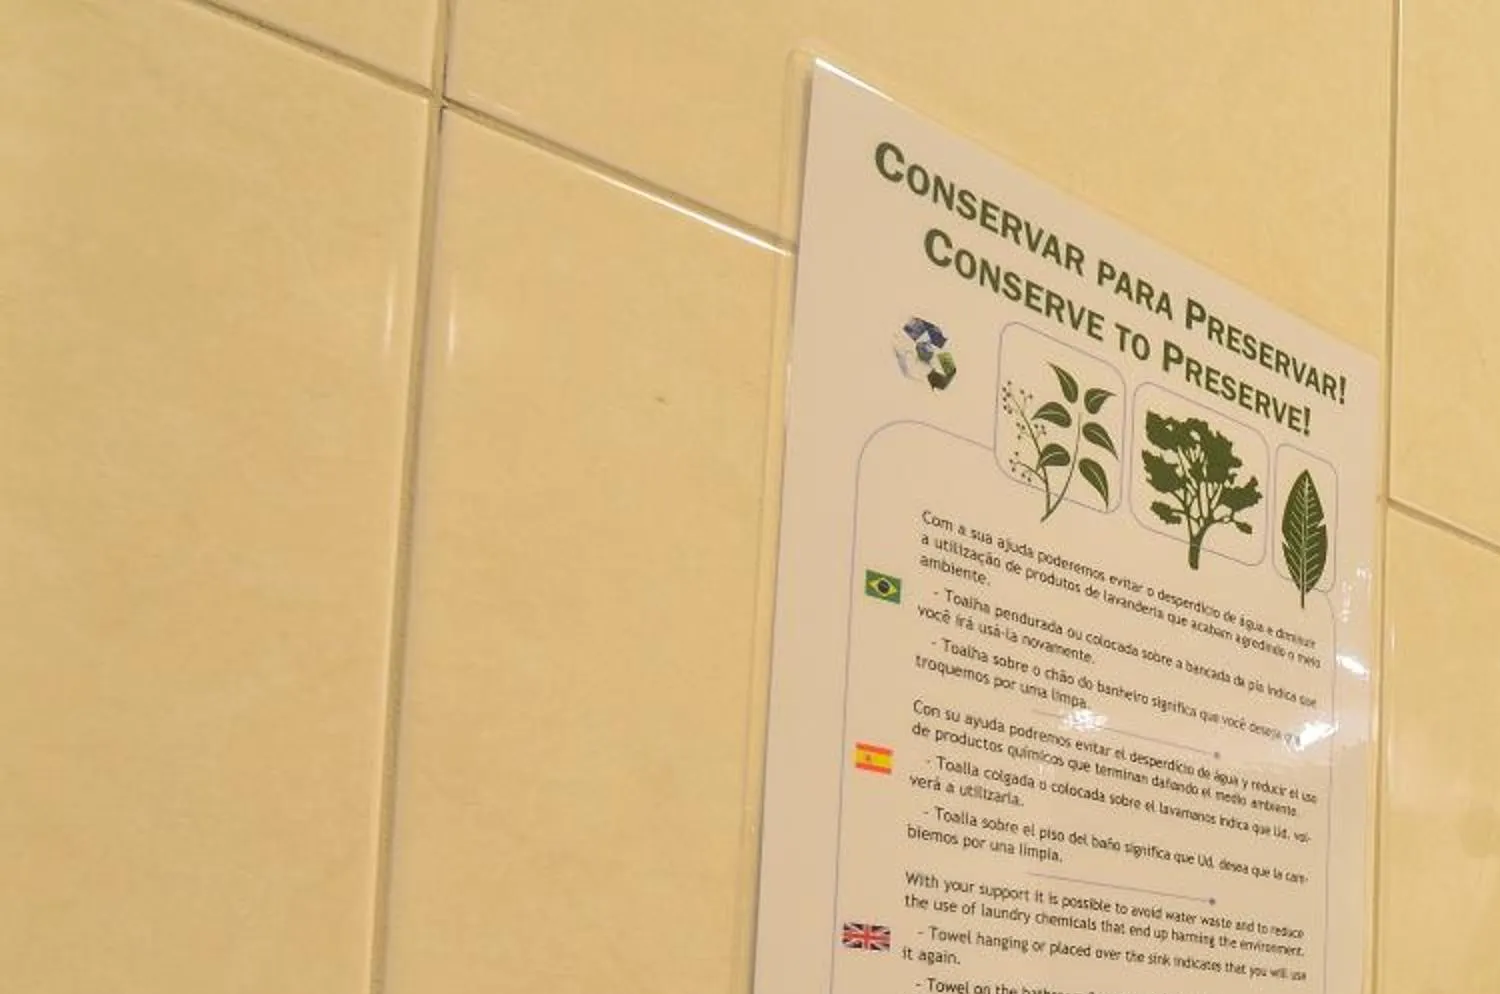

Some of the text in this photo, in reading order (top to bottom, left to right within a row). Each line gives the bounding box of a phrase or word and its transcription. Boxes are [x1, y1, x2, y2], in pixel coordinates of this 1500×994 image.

[875, 143, 1346, 404] CONSERVAR PARA PRESERVAR!
[924, 229, 1310, 436] CONSERVE TO PRESERVE!
[921, 510, 953, 532] Com
[957, 525, 967, 536] a
[970, 529, 993, 545] sua
[997, 537, 1034, 559] ajuda
[1037, 551, 1105, 582] poderemos
[1109, 575, 1144, 593] evitar
[1147, 587, 1155, 597] o
[1223, 610, 1237, 624] de
[921, 533, 930, 546] a
[934, 538, 1001, 569] utilização
[1005, 559, 1023, 575] de
[1025, 567, 1081, 594] produtos
[1083, 584, 1101, 600] de
[1103, 589, 1165, 620] lavanderia
[1167, 613, 1188, 627] que
[1287, 651, 1295, 661] o
[944, 587, 991, 615] Toalha
[994, 607, 1063, 635] pendurada
[1067, 627, 1083, 641] ou
[1085, 632, 1139, 657] colocada
[1141, 649, 1173, 667] sobre
[1175, 659, 1183, 670] a
[1021, 633, 1096, 665] novamente.
[915, 654, 1049, 699] troquemos por uma
[941, 637, 989, 663] Toalha
[993, 655, 1029, 673] sobre
[1032, 665, 1041, 677] o
[1077, 676, 1094, 691] do
[910, 721, 932, 738] de
[934, 728, 1004, 754] productos
[1067, 758, 1092, 774] que
[1094, 762, 1149, 785] terminan
[1200, 786, 1212, 799] el
[912, 698, 942, 719] Con
[944, 709, 961, 724] su
[963, 714, 1006, 734] ayuda
[1008, 724, 1072, 749] podremos
[1074, 739, 1112, 757] evitar
[1114, 748, 1127, 761] el
[1196, 766, 1211, 781] de
[1288, 788, 1299, 800] el
[909, 775, 942, 792] verá
[945, 783, 955, 794] a
[936, 755, 979, 777] Toalla
[983, 769, 1035, 789] colgada
[1039, 780, 1047, 791] o
[1049, 781, 1106, 803] colocada
[1109, 793, 1142, 810] sobre
[1144, 799, 1156, 813] el
[1251, 823, 1271, 837] que
[906, 823, 1063, 864] biemos por una limpia.
[934, 805, 978, 827] Toalla
[981, 817, 1019, 834] sobre
[1022, 823, 1035, 837] el
[1039, 827, 1065, 842] piso
[1068, 831, 1089, 847] del
[1173, 852, 1195, 865] que
[1251, 866, 1270, 879] que
[904, 870, 940, 890] With
[943, 879, 976, 894] your
[978, 884, 1030, 903] support
[1048, 892, 1060, 906] is
[1060, 896, 1112, 914] possible
[1114, 902, 1129, 916] to
[1130, 905, 1163, 920] avoid
[1165, 911, 1198, 925] water
[1199, 915, 1234, 930] waste
[1234, 920, 1256, 933] and
[1256, 921, 1269, 935] to
[905, 893, 929, 910] the
[933, 900, 958, 913] use
[961, 901, 976, 916] of
[981, 903, 1031, 925] laundry
[1035, 912, 1097, 931] chemicals
[1101, 920, 1125, 935] that
[1129, 924, 1151, 938] end
[1153, 929, 1169, 942] up
[1171, 928, 1215, 949] harming
[1218, 935, 1237, 949] the
[917, 950, 961, 966] again.
[928, 925, 972, 944] Towel
[975, 931, 1029, 954] hanging
[1031, 941, 1046, 952] or
[1049, 941, 1091, 958] placed
[1095, 948, 1122, 961] over
[1125, 950, 1145, 963] the
[1147, 952, 1171, 967] sink
[1225, 961, 1247, 975] that
